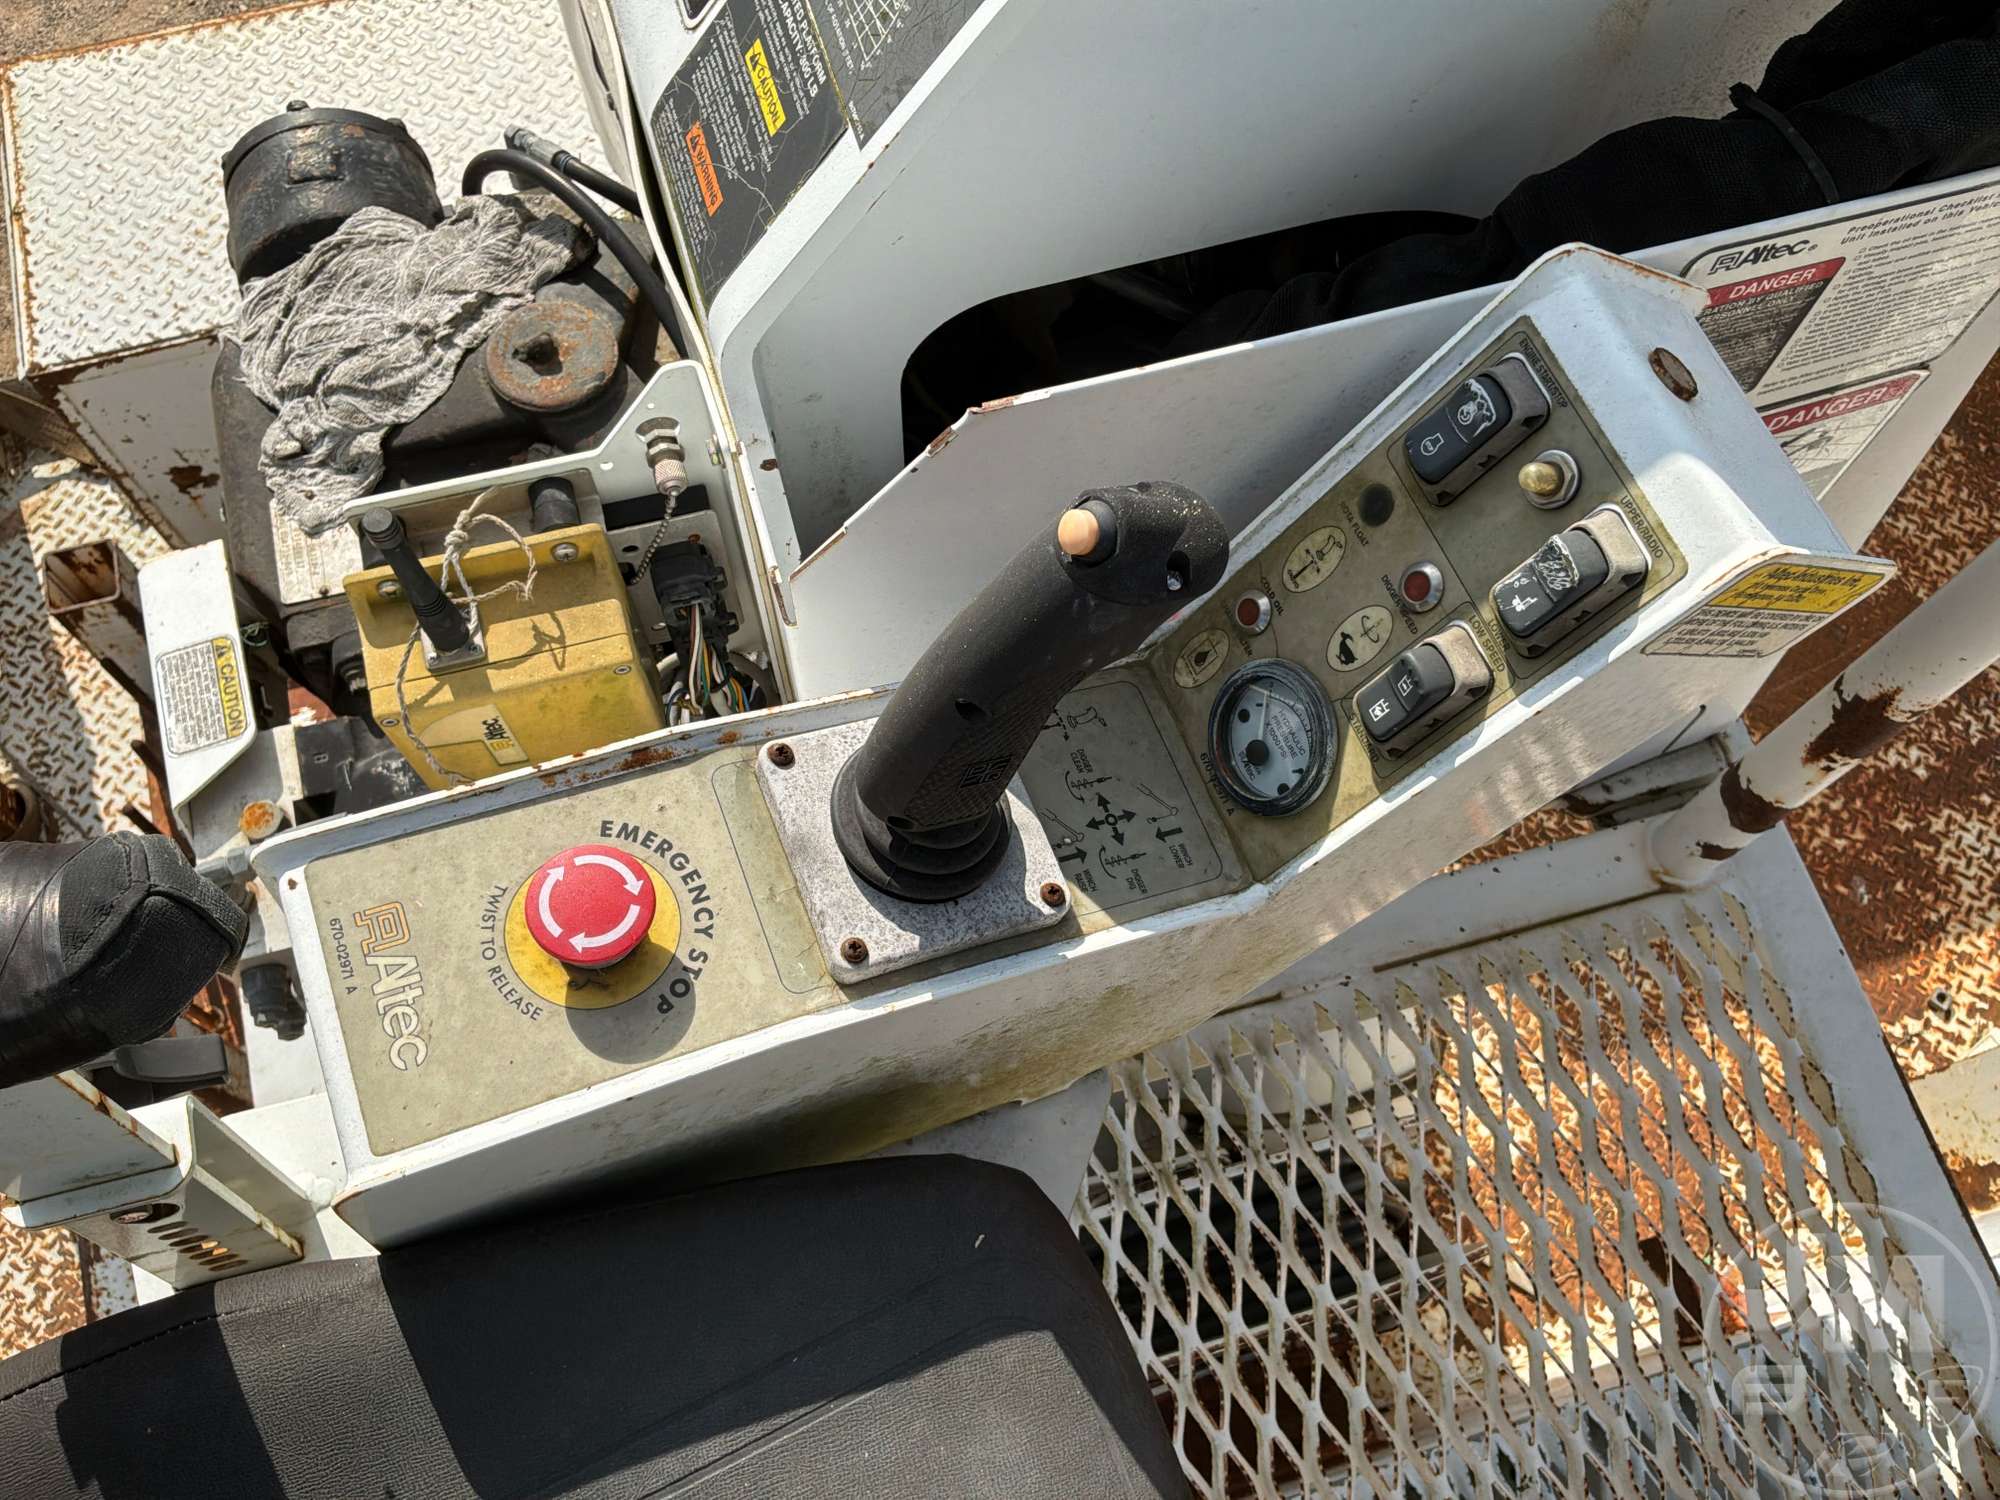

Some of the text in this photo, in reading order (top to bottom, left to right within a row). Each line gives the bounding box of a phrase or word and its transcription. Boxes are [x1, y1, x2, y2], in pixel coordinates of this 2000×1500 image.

[800, 20, 827, 85] PLATFORM
[756, 67, 780, 125] CAUTION
[697, 151, 719, 206] WARNING
[1741, 240, 1810, 266] Altec
[1729, 268, 1816, 299] DANGER
[1517, 337, 1569, 409] ENGINE START/STOP
[1768, 387, 1888, 431] DANGER
[1350, 522, 1369, 547] FLOAT
[1620, 495, 1663, 559] UPPER/RADIO
[1258, 576, 1285, 616] COLD OIL
[1378, 574, 1420, 636] DIGGER SPEED
[1466, 614, 1508, 673] LOW SPEED
[1485, 618, 1512, 652] LOWER
[220, 663, 243, 731] CAUTION
[482, 718, 510, 740] Altec
[1271, 715, 1298, 760] PRESSURE
[1279, 709, 1305, 756] HYDRAULIC
[1348, 712, 1380, 762] STANDARD
[1070, 751, 1084, 773] CLEAN
[1076, 748, 1093, 773] DIGGER
[1225, 806, 1236, 816] A
[1168, 844, 1184, 869] LOWER
[1177, 843, 1193, 865] WINCH
[1073, 872, 1088, 893] RAISE
[1082, 868, 1097, 892] WINCH
[1125, 876, 1136, 890] DIG
[1130, 868, 1147, 894] DIGGER
[599, 820, 715, 1017] EMERGENCY STOP
[328, 917, 356, 996] 670-02971 A
[480, 884, 543, 1022] TWIST TO RELEASE
[365, 952, 429, 1072] Altec
